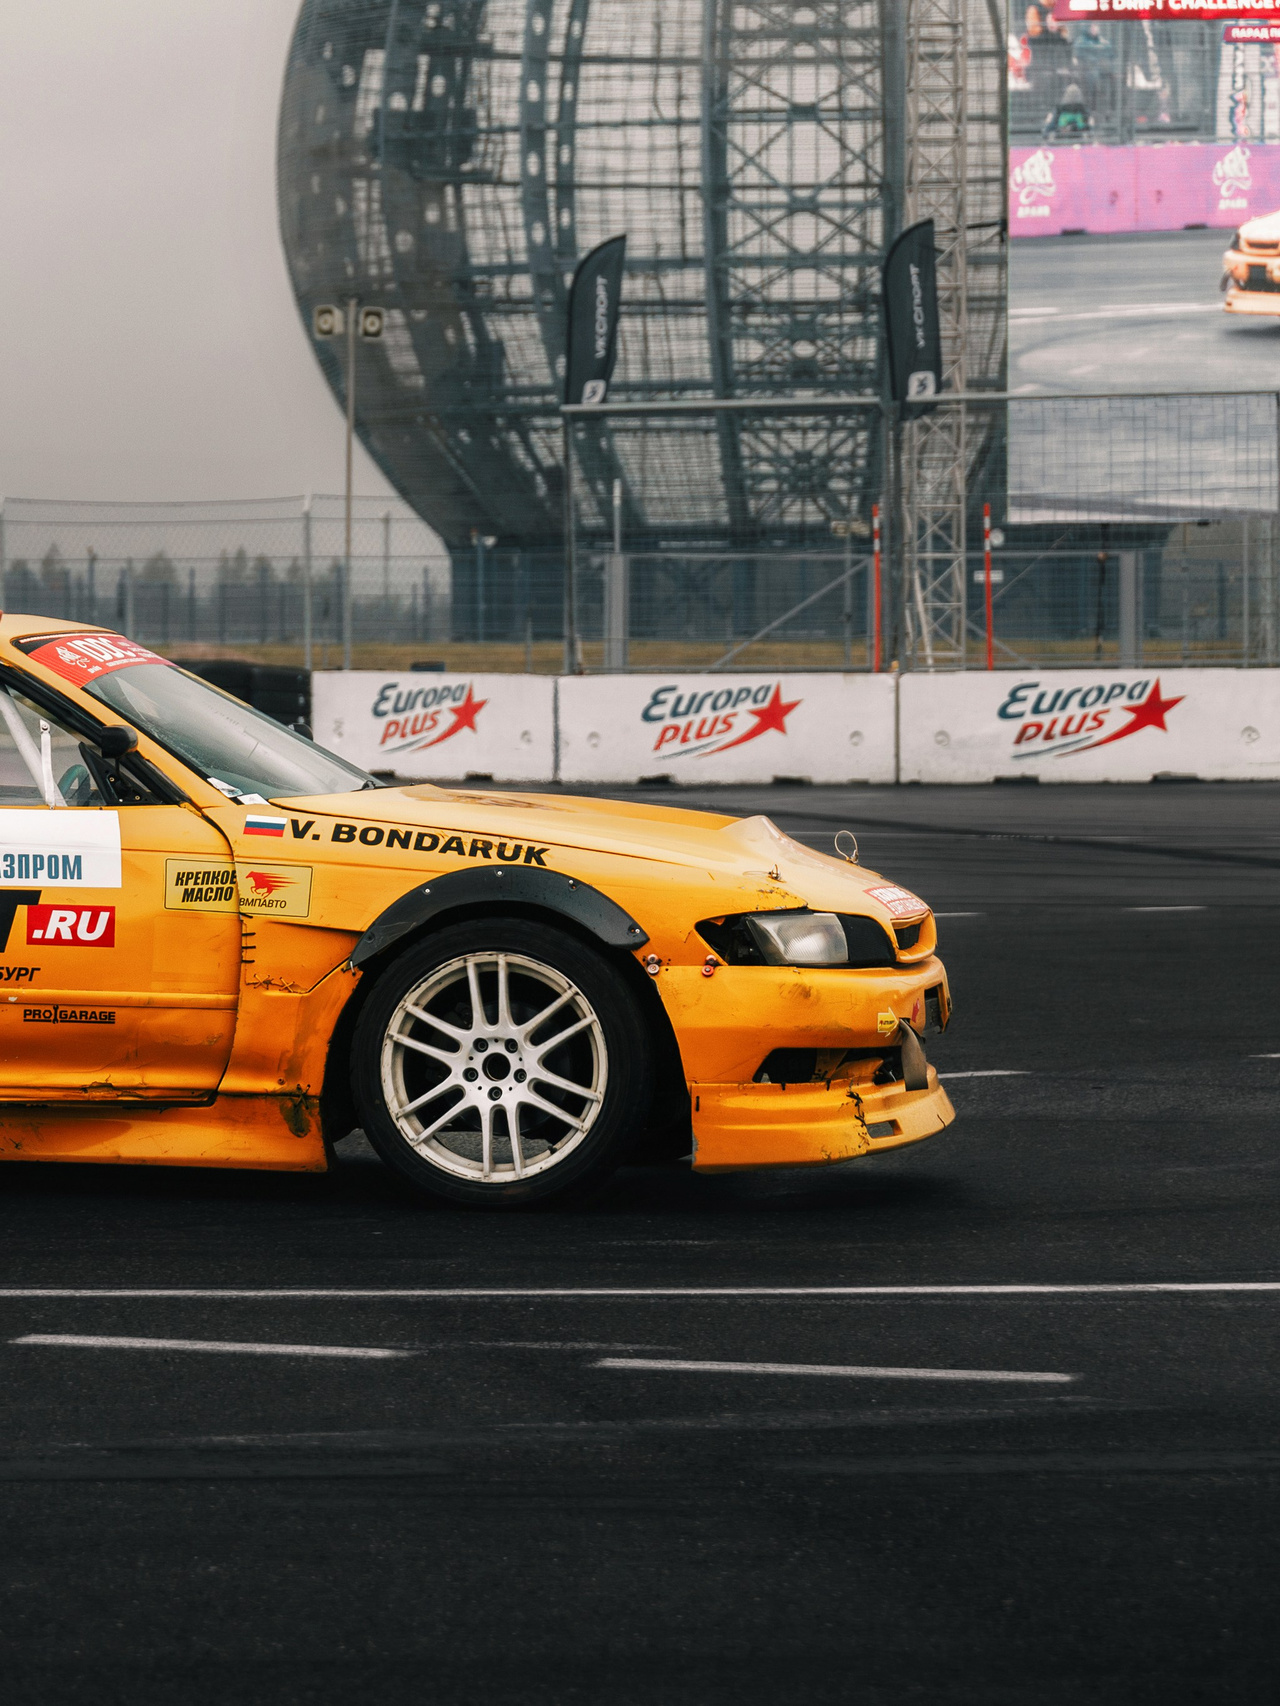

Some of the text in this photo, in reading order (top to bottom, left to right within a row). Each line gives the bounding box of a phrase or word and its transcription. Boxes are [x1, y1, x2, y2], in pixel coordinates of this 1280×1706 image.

[290, 818, 552, 867] V. BONDARUK
[181, 886, 235, 903] МАСЛО
[239, 897, 288, 909] ВМПАВТО
[32, 909, 111, 942] .RU
